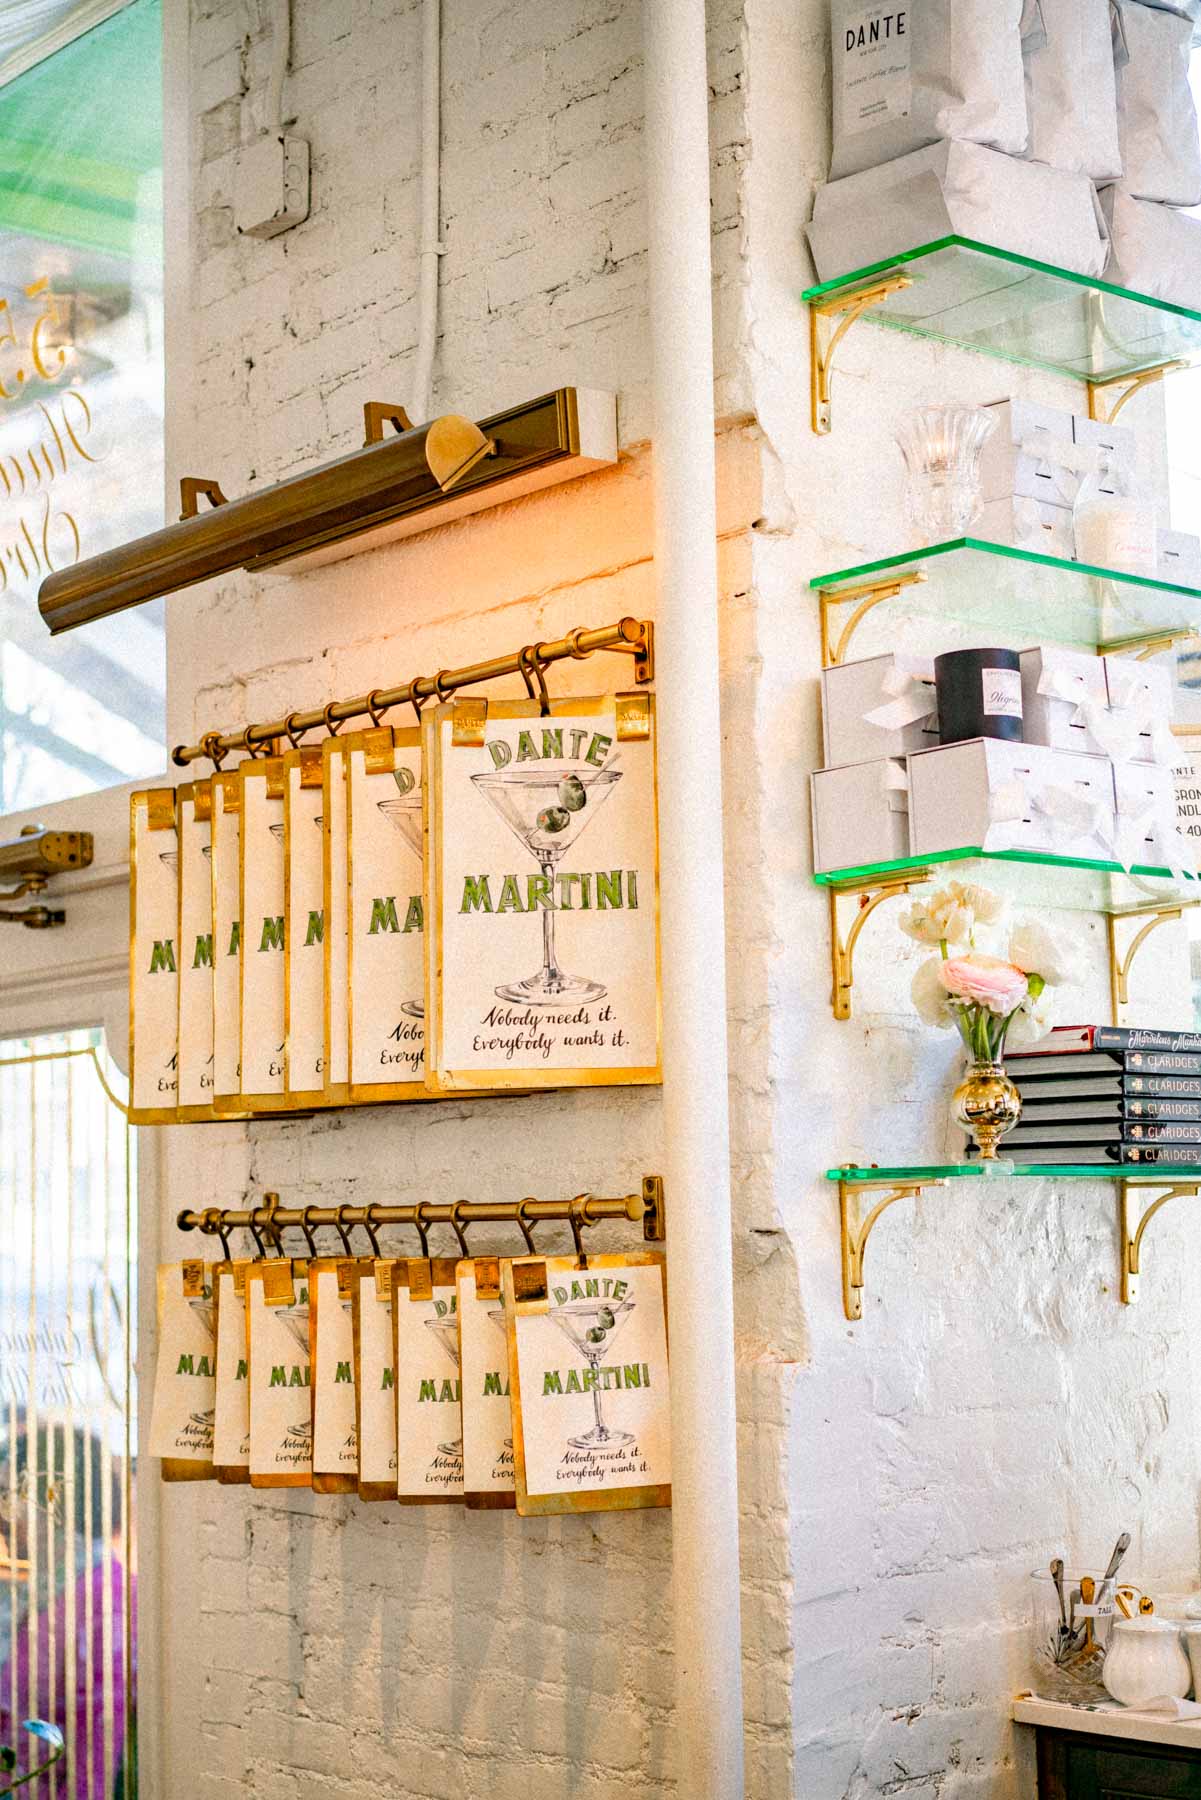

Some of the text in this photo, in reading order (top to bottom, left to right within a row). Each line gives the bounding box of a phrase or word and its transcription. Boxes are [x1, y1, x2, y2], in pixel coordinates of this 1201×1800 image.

[846, 12, 906, 52] DANTE
[486, 728, 613, 771] DANTE
[458, 869, 639, 914] MARTINI
[480, 1004, 618, 1037] Nobody needs it.
[472, 1028, 631, 1060] Everybody wants it.
[552, 1277, 628, 1306] DANTE
[542, 1362, 651, 1396] MARTINI
[556, 1465, 605, 1484] Everybody
[611, 1461, 636, 1473] wants
[560, 1450, 597, 1469] Nobody
[600, 1448, 626, 1460] needs
